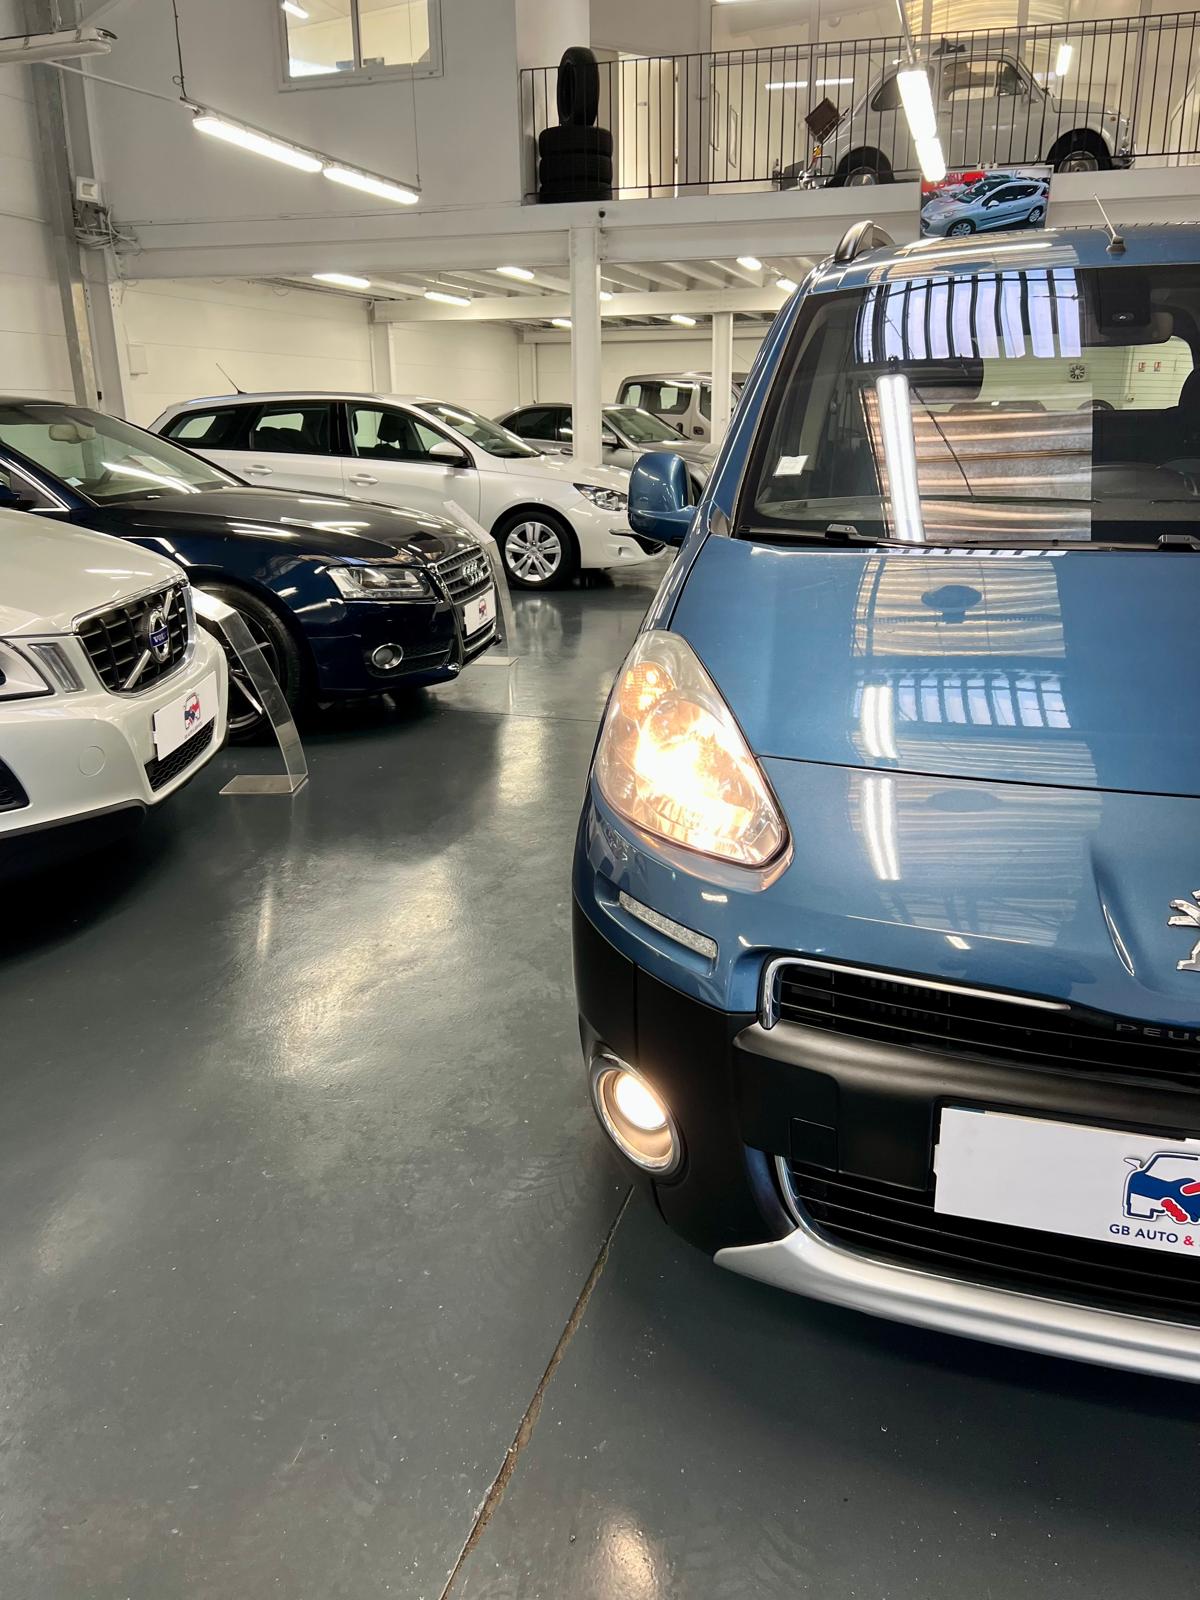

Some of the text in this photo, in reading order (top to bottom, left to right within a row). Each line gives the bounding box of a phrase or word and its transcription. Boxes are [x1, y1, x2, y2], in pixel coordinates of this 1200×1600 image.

[1116, 1023, 1200, 1042] PEU
[1109, 1223, 1195, 1246] GB AUTO &
